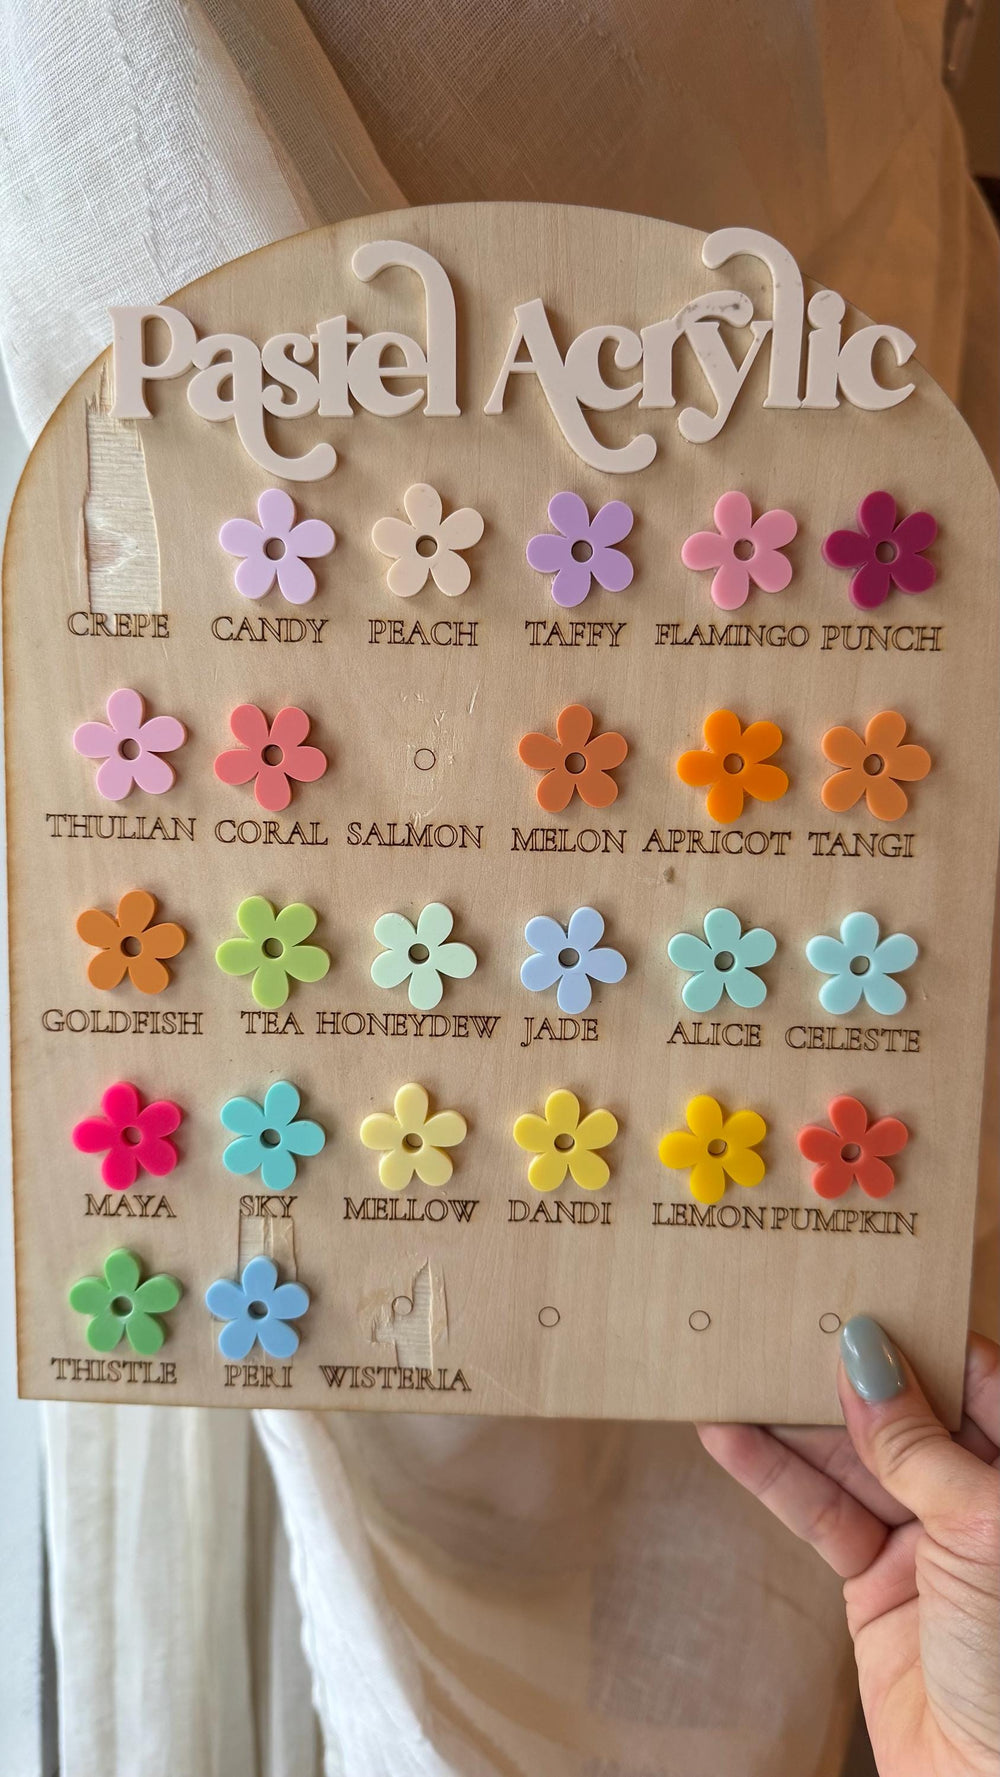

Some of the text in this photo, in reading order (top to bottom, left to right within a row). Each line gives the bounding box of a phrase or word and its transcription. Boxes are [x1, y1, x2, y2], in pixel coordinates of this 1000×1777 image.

[111, 227, 917, 481] Pastel Acrylic
[68, 612, 170, 638] CREPE
[211, 617, 329, 644] CANDY
[368, 620, 479, 647] PEACH
[525, 621, 627, 647] TAFFY
[655, 624, 810, 648] FLAMINGO
[821, 624, 943, 651] PUNCH
[46, 813, 197, 841] THULIAN
[214, 818, 328, 845] CORAL
[346, 820, 483, 848] SALMON
[511, 826, 628, 853] MELON
[642, 829, 792, 856] APRICOT
[807, 832, 915, 858] TANGI
[42, 1009, 204, 1035] GOLDFISH
[240, 1011, 304, 1036] TEA
[316, 1012, 500, 1038] HONEYDEW
[520, 1017, 599, 1045] JADE
[667, 1023, 762, 1047] ALICE
[785, 1026, 922, 1052] CELESTE
[84, 1194, 177, 1219] MAYA
[239, 1194, 297, 1219] SKY
[343, 1198, 479, 1222] MELLOW
[508, 1199, 613, 1224] DANDI
[652, 1203, 768, 1229] LEMON
[770, 1206, 918, 1234] PUMPKIN
[51, 1358, 178, 1384] THISTLE
[224, 1364, 293, 1387] PERI
[319, 1366, 472, 1393] WISTERIA
